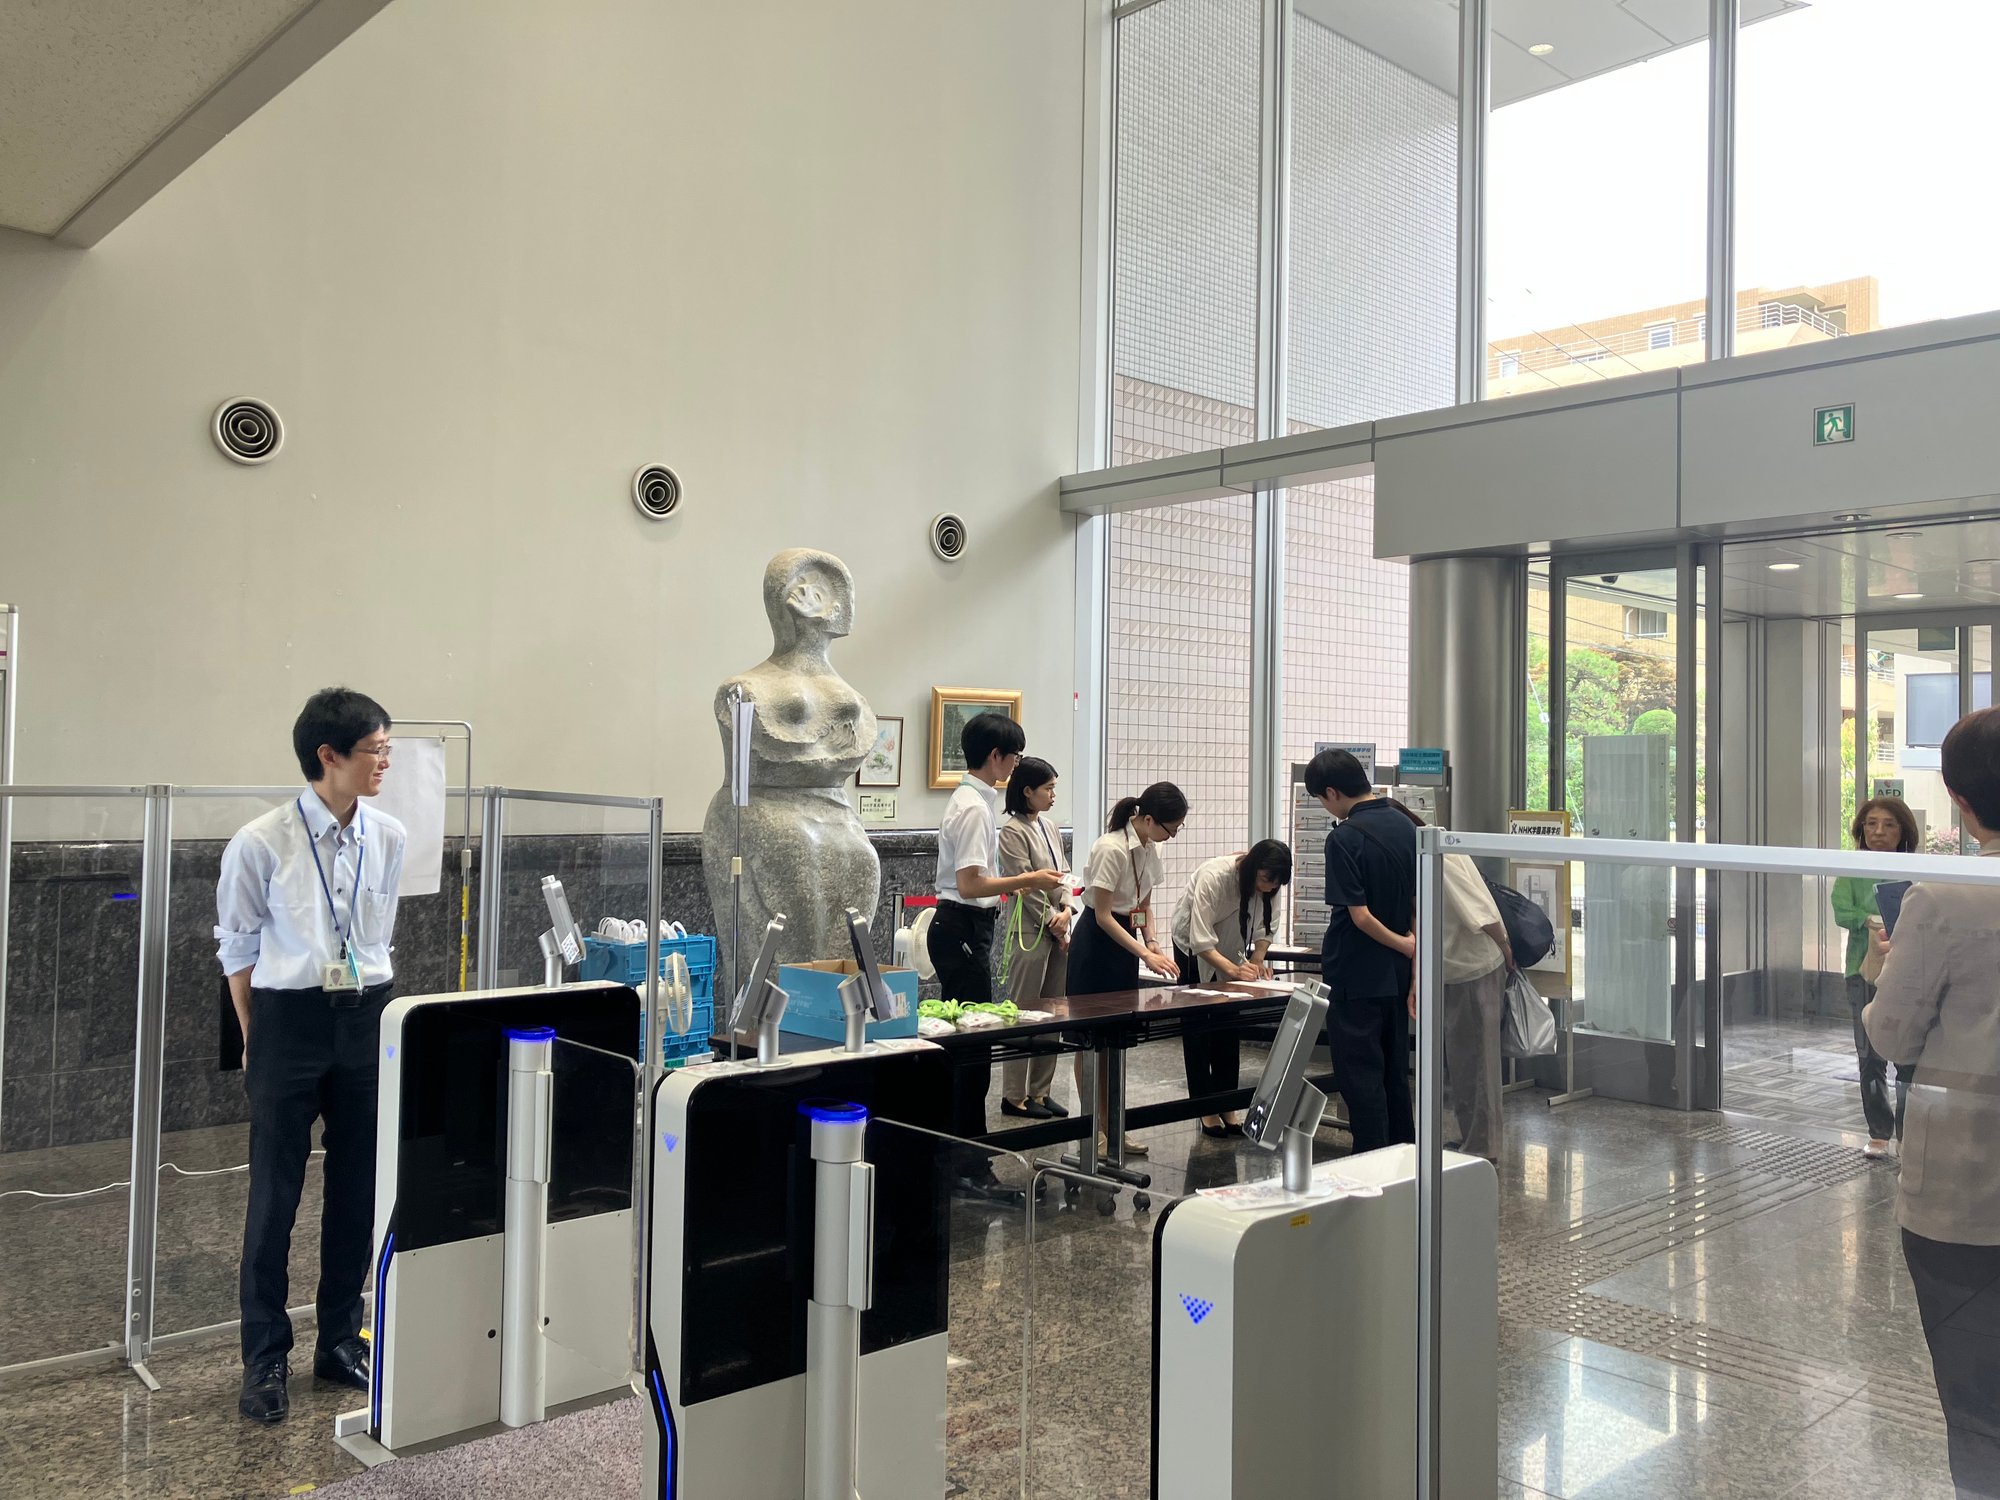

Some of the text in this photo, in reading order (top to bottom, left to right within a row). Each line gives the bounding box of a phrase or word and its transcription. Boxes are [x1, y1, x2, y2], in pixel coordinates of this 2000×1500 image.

[1518, 826, 1561, 835] NHK学園高等学校
